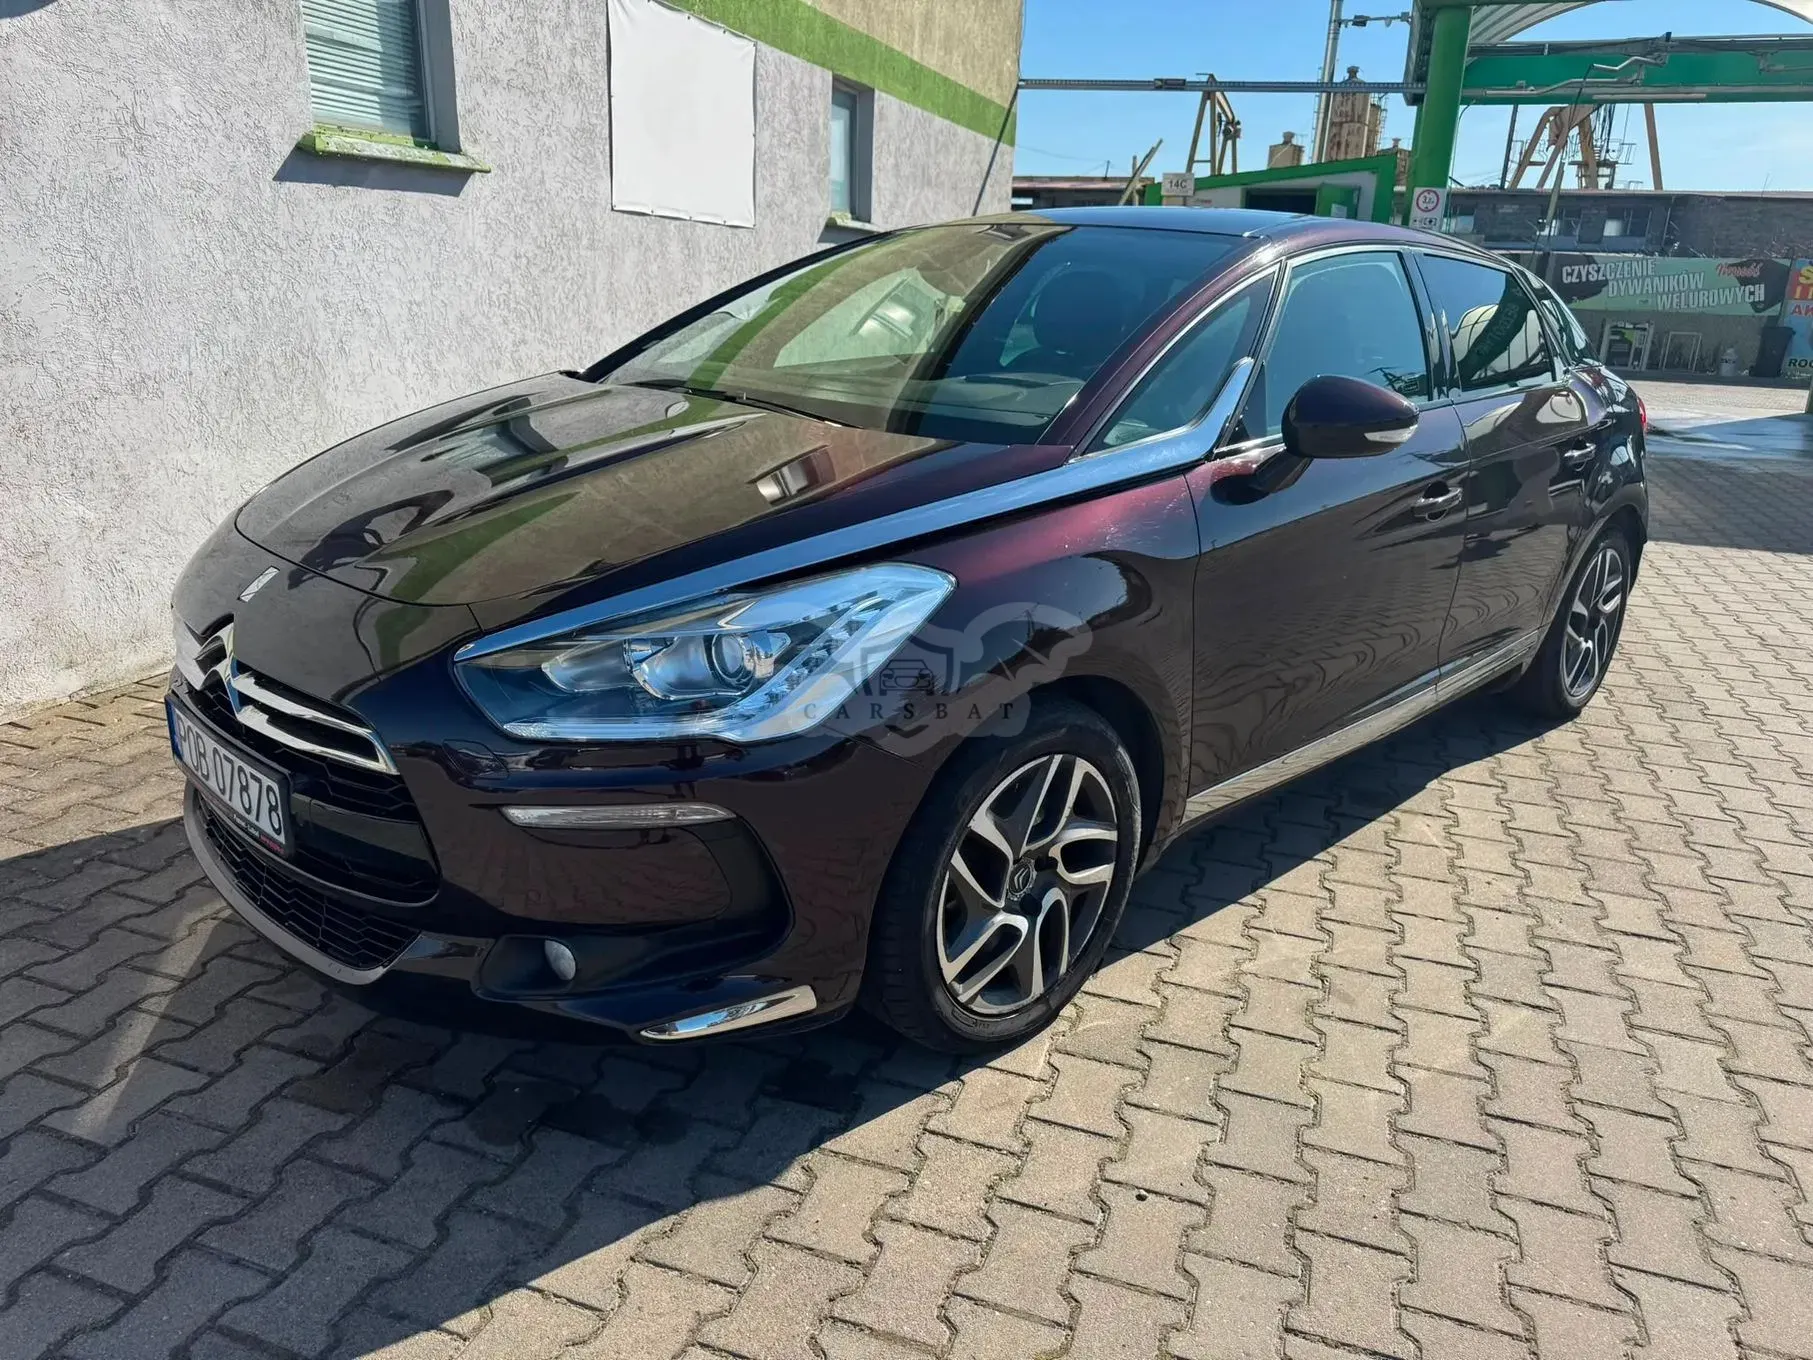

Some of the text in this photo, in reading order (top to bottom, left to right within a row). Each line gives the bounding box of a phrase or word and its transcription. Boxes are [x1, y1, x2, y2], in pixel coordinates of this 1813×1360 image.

[1168, 180, 1187, 189] 14C
[1562, 259, 1655, 283] CZYSZCZENIE
[1608, 269, 1704, 298] DYWANIKÓW
[1657, 283, 1765, 311] WELUROWYCH
[175, 711, 283, 836] POB 07878
